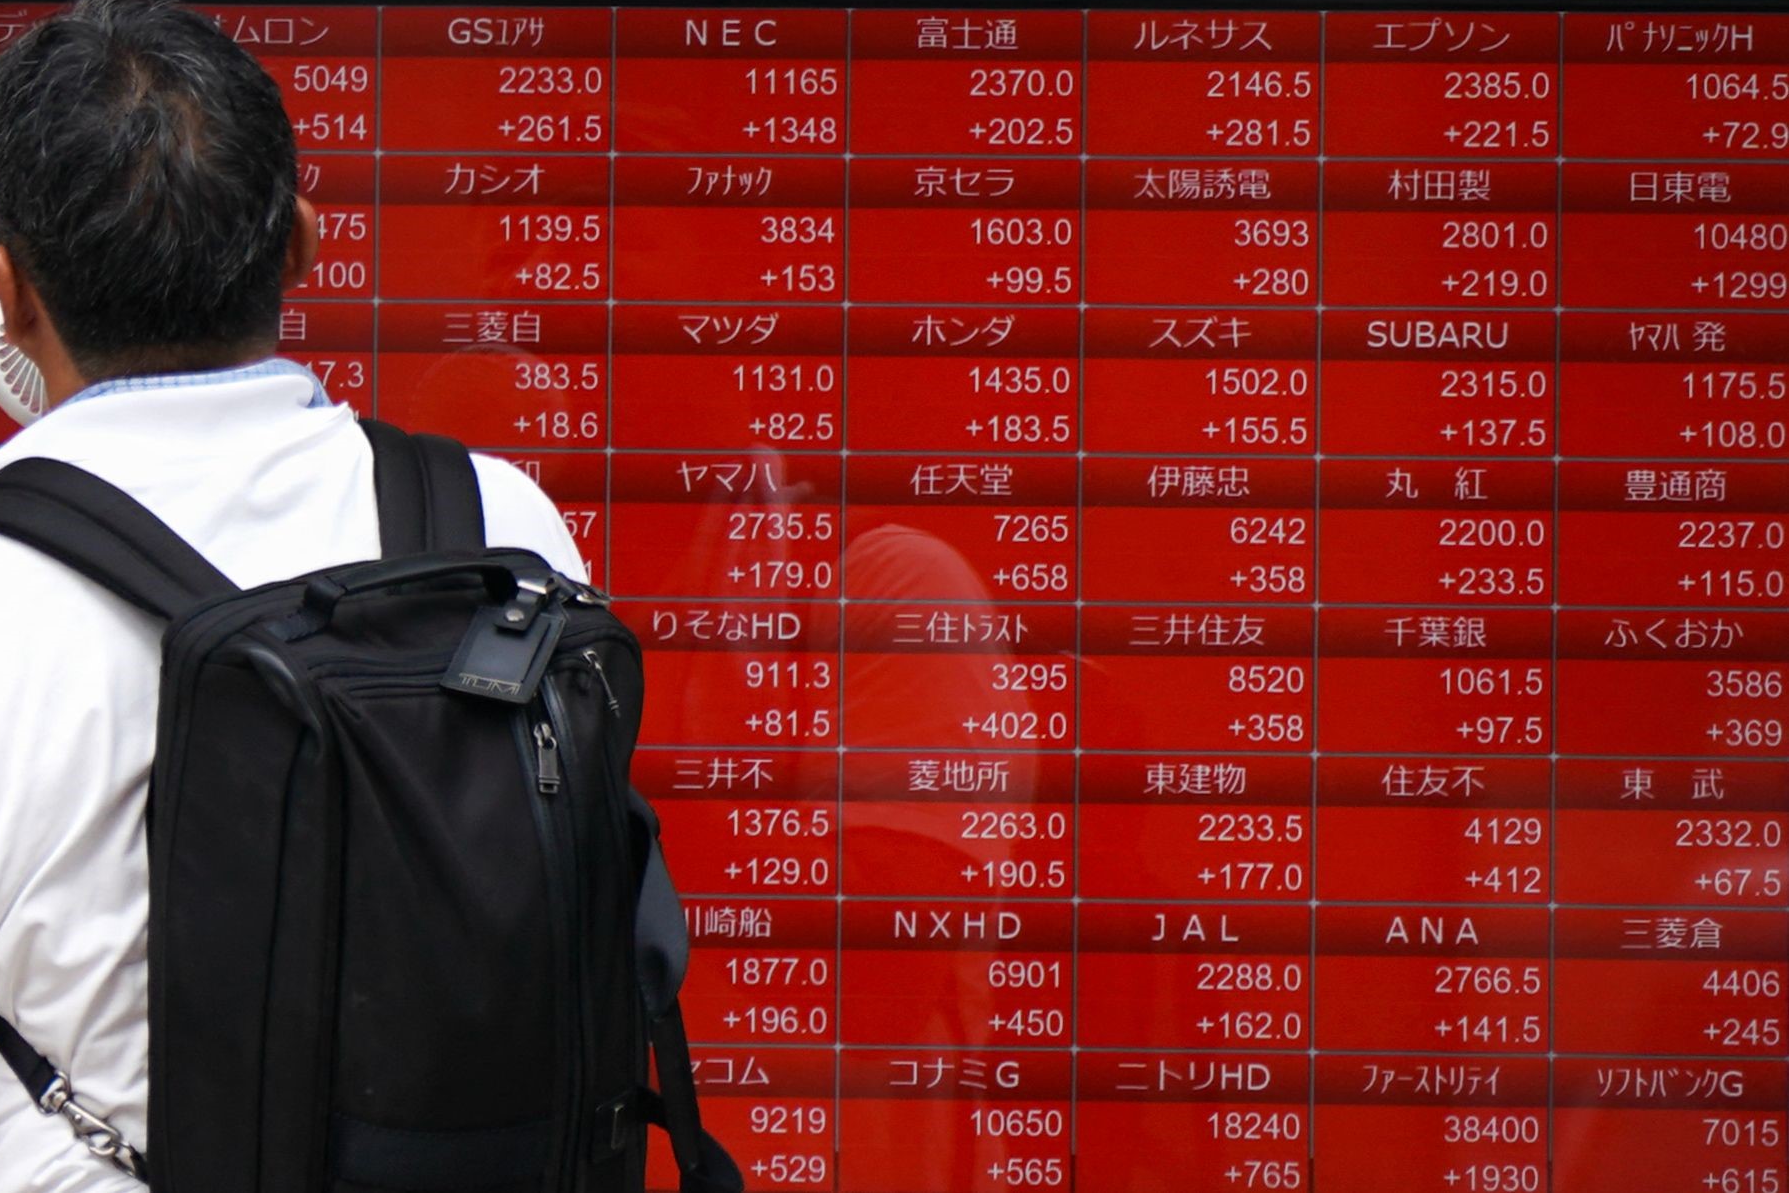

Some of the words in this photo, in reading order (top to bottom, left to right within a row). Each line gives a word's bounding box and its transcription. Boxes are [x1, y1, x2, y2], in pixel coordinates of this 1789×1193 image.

[916, 15, 1018, 50] 富士通
[1373, 16, 1511, 52] エプソン
[969, 68, 1074, 97] 2370.0
[1444, 71, 1550, 99] 2385.0
[969, 117, 1074, 145] +202.5
[1443, 120, 1550, 148] +221.5
[445, 162, 545, 195] カシオ
[500, 214, 601, 242] 1139.5
[515, 262, 601, 290] +82.5
[443, 310, 541, 343] 三菱自
[911, 314, 1015, 347] ホンダ
[1367, 320, 1508, 349] SUBARU
[514, 361, 599, 391] 383.5
[969, 366, 1071, 394] 1435.0
[1440, 370, 1547, 398] 2315.0
[513, 410, 599, 439] +18.6
[965, 414, 1070, 443] +183.5
[1440, 418, 1547, 447] +137.5
[1147, 465, 1250, 498] 伊藤忠
[1229, 516, 1306, 545] 6242
[1229, 565, 1306, 593] +358
[1385, 615, 1486, 648] 千葉銀
[458, 672, 522, 696] TUMI
[745, 660, 831, 689] 911.3
[1440, 667, 1543, 696] 1061.5
[745, 708, 831, 738] +81.5
[1456, 716, 1543, 744] +97.5
[908, 759, 1010, 792] 菱地所
[960, 810, 1066, 840] 2263.0
[960, 859, 1065, 888] +190.5
[1624, 916, 1723, 949] 三菱倉
[1702, 969, 1780, 998] 4406
[1703, 1017, 1780, 1046] +245
[1207, 1111, 1301, 1141] 18240
[1224, 1160, 1301, 1190] +765
